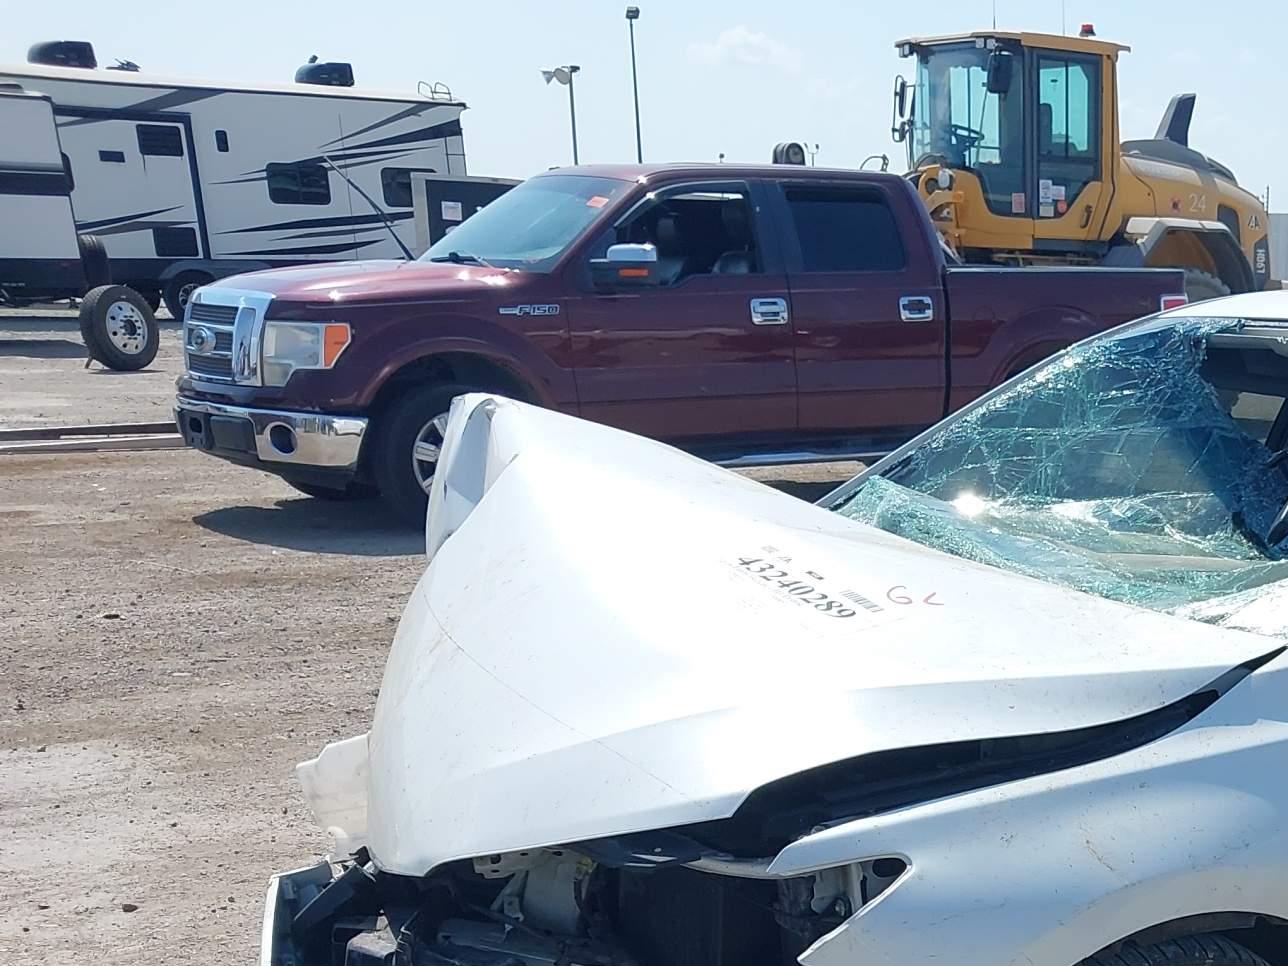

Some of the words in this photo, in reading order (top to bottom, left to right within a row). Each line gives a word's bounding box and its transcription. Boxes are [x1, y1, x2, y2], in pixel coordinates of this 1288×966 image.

[1189, 194, 1206, 213] 24
[1256, 249, 1266, 274] L90H
[738, 556, 857, 618] 43240289
